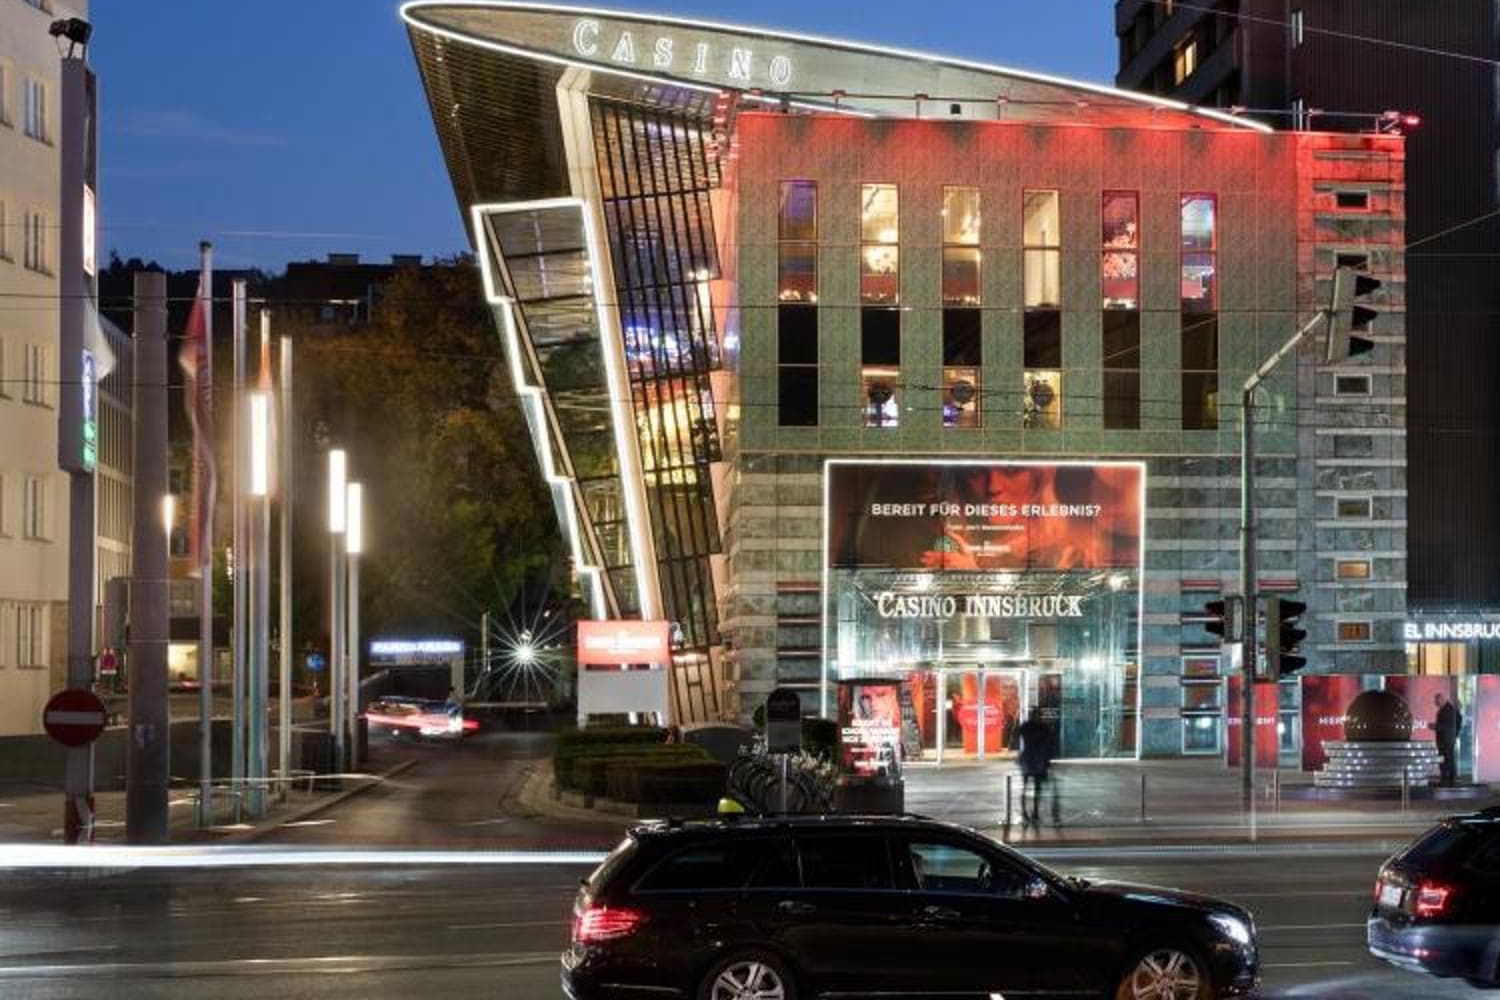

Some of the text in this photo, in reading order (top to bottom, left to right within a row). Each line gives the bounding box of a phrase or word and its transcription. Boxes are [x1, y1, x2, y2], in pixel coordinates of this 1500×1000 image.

[571, 17, 794, 87] CASINO
[871, 500, 1102, 517] BEREIT FÜR DIESES ERLEBNIS?
[876, 591, 1084, 618] CASINO INNSBRUCK
